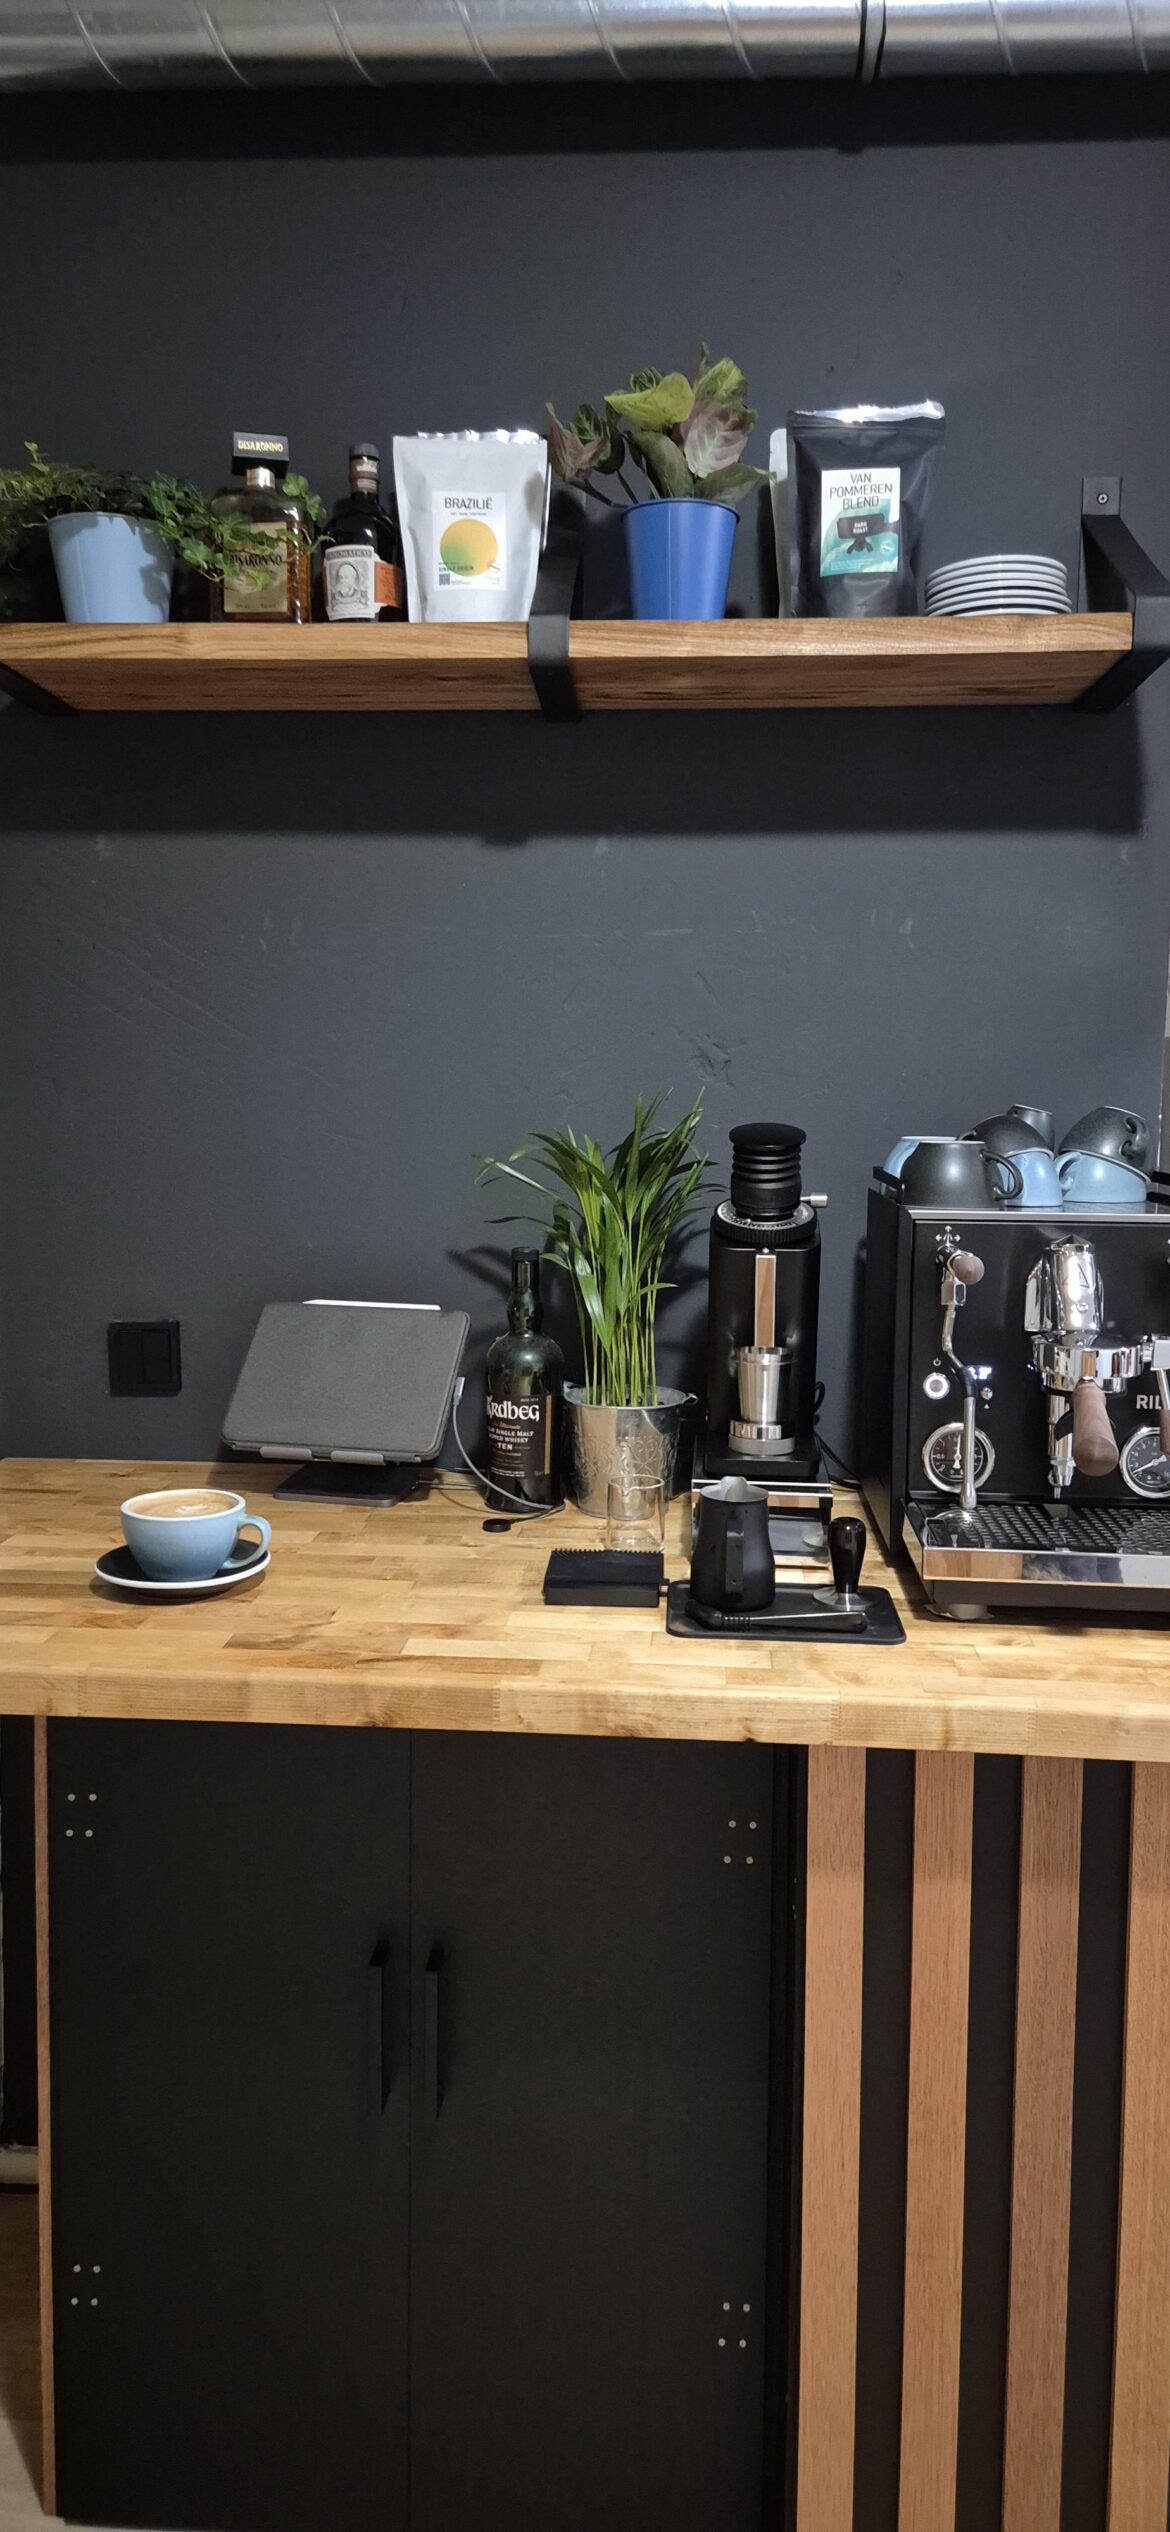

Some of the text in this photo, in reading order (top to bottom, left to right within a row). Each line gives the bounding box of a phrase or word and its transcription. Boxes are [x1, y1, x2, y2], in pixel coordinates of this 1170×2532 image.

[237, 439, 284, 453] DISARONNO
[850, 473, 872, 484] VAN
[829, 483, 893, 498] POMMEREN
[444, 496, 493, 510] BRAZILIË
[842, 496, 879, 511] BLEND
[497, 1442, 513, 1450] TEN
